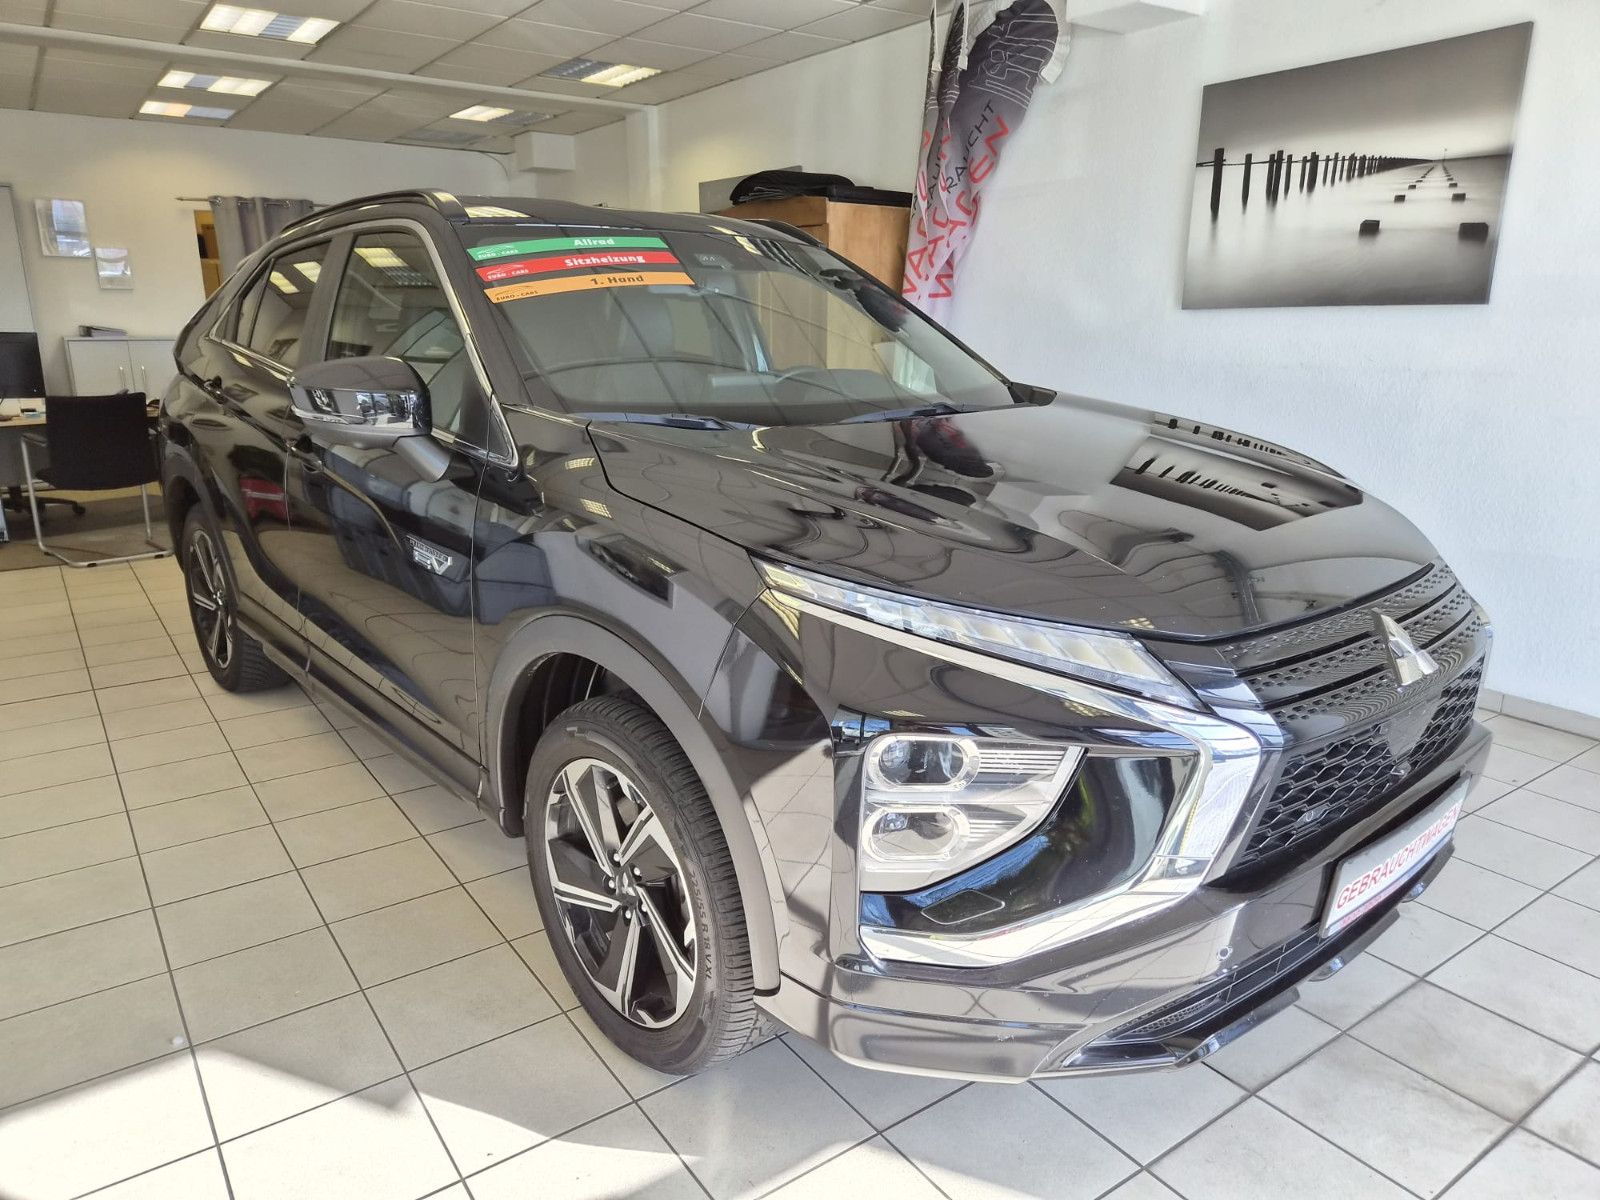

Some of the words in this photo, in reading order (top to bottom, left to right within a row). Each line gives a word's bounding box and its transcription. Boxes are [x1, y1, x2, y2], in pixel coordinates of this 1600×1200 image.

[574, 238, 615, 247] Allrad
[564, 255, 646, 267] Sitzheizung
[590, 278, 604, 286] 1.
[607, 274, 645, 284] Hand
[1336, 806, 1458, 910] GEBRAUCHTWAGEN
